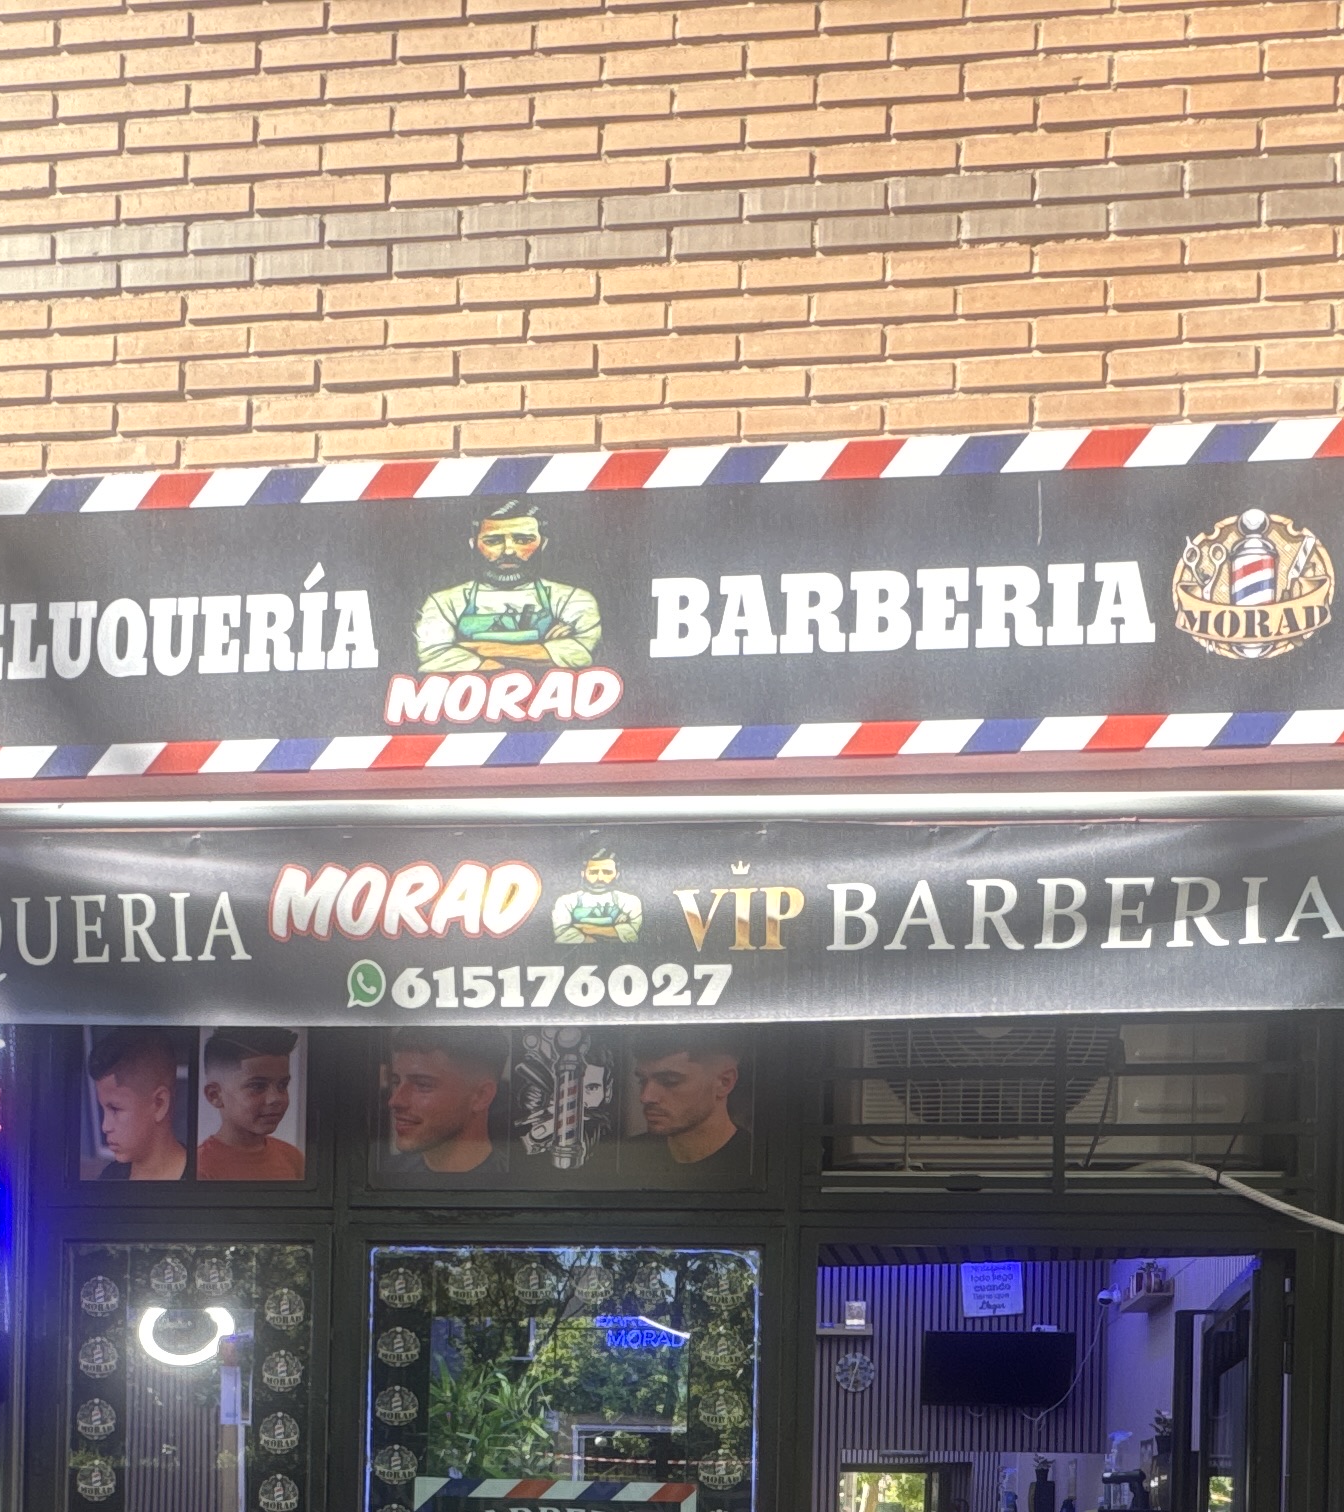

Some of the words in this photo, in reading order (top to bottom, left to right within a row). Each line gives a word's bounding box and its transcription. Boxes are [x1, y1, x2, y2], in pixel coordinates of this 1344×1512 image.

[649, 560, 1156, 659] BARBERIA
[1183, 603, 1330, 639] MORAD
[384, 668, 624, 726] MORAD
[269, 860, 541, 943] MORAD
[673, 885, 806, 953] VIP
[391, 963, 732, 1009] 615176027
[606, 1328, 686, 1349] MORAD
